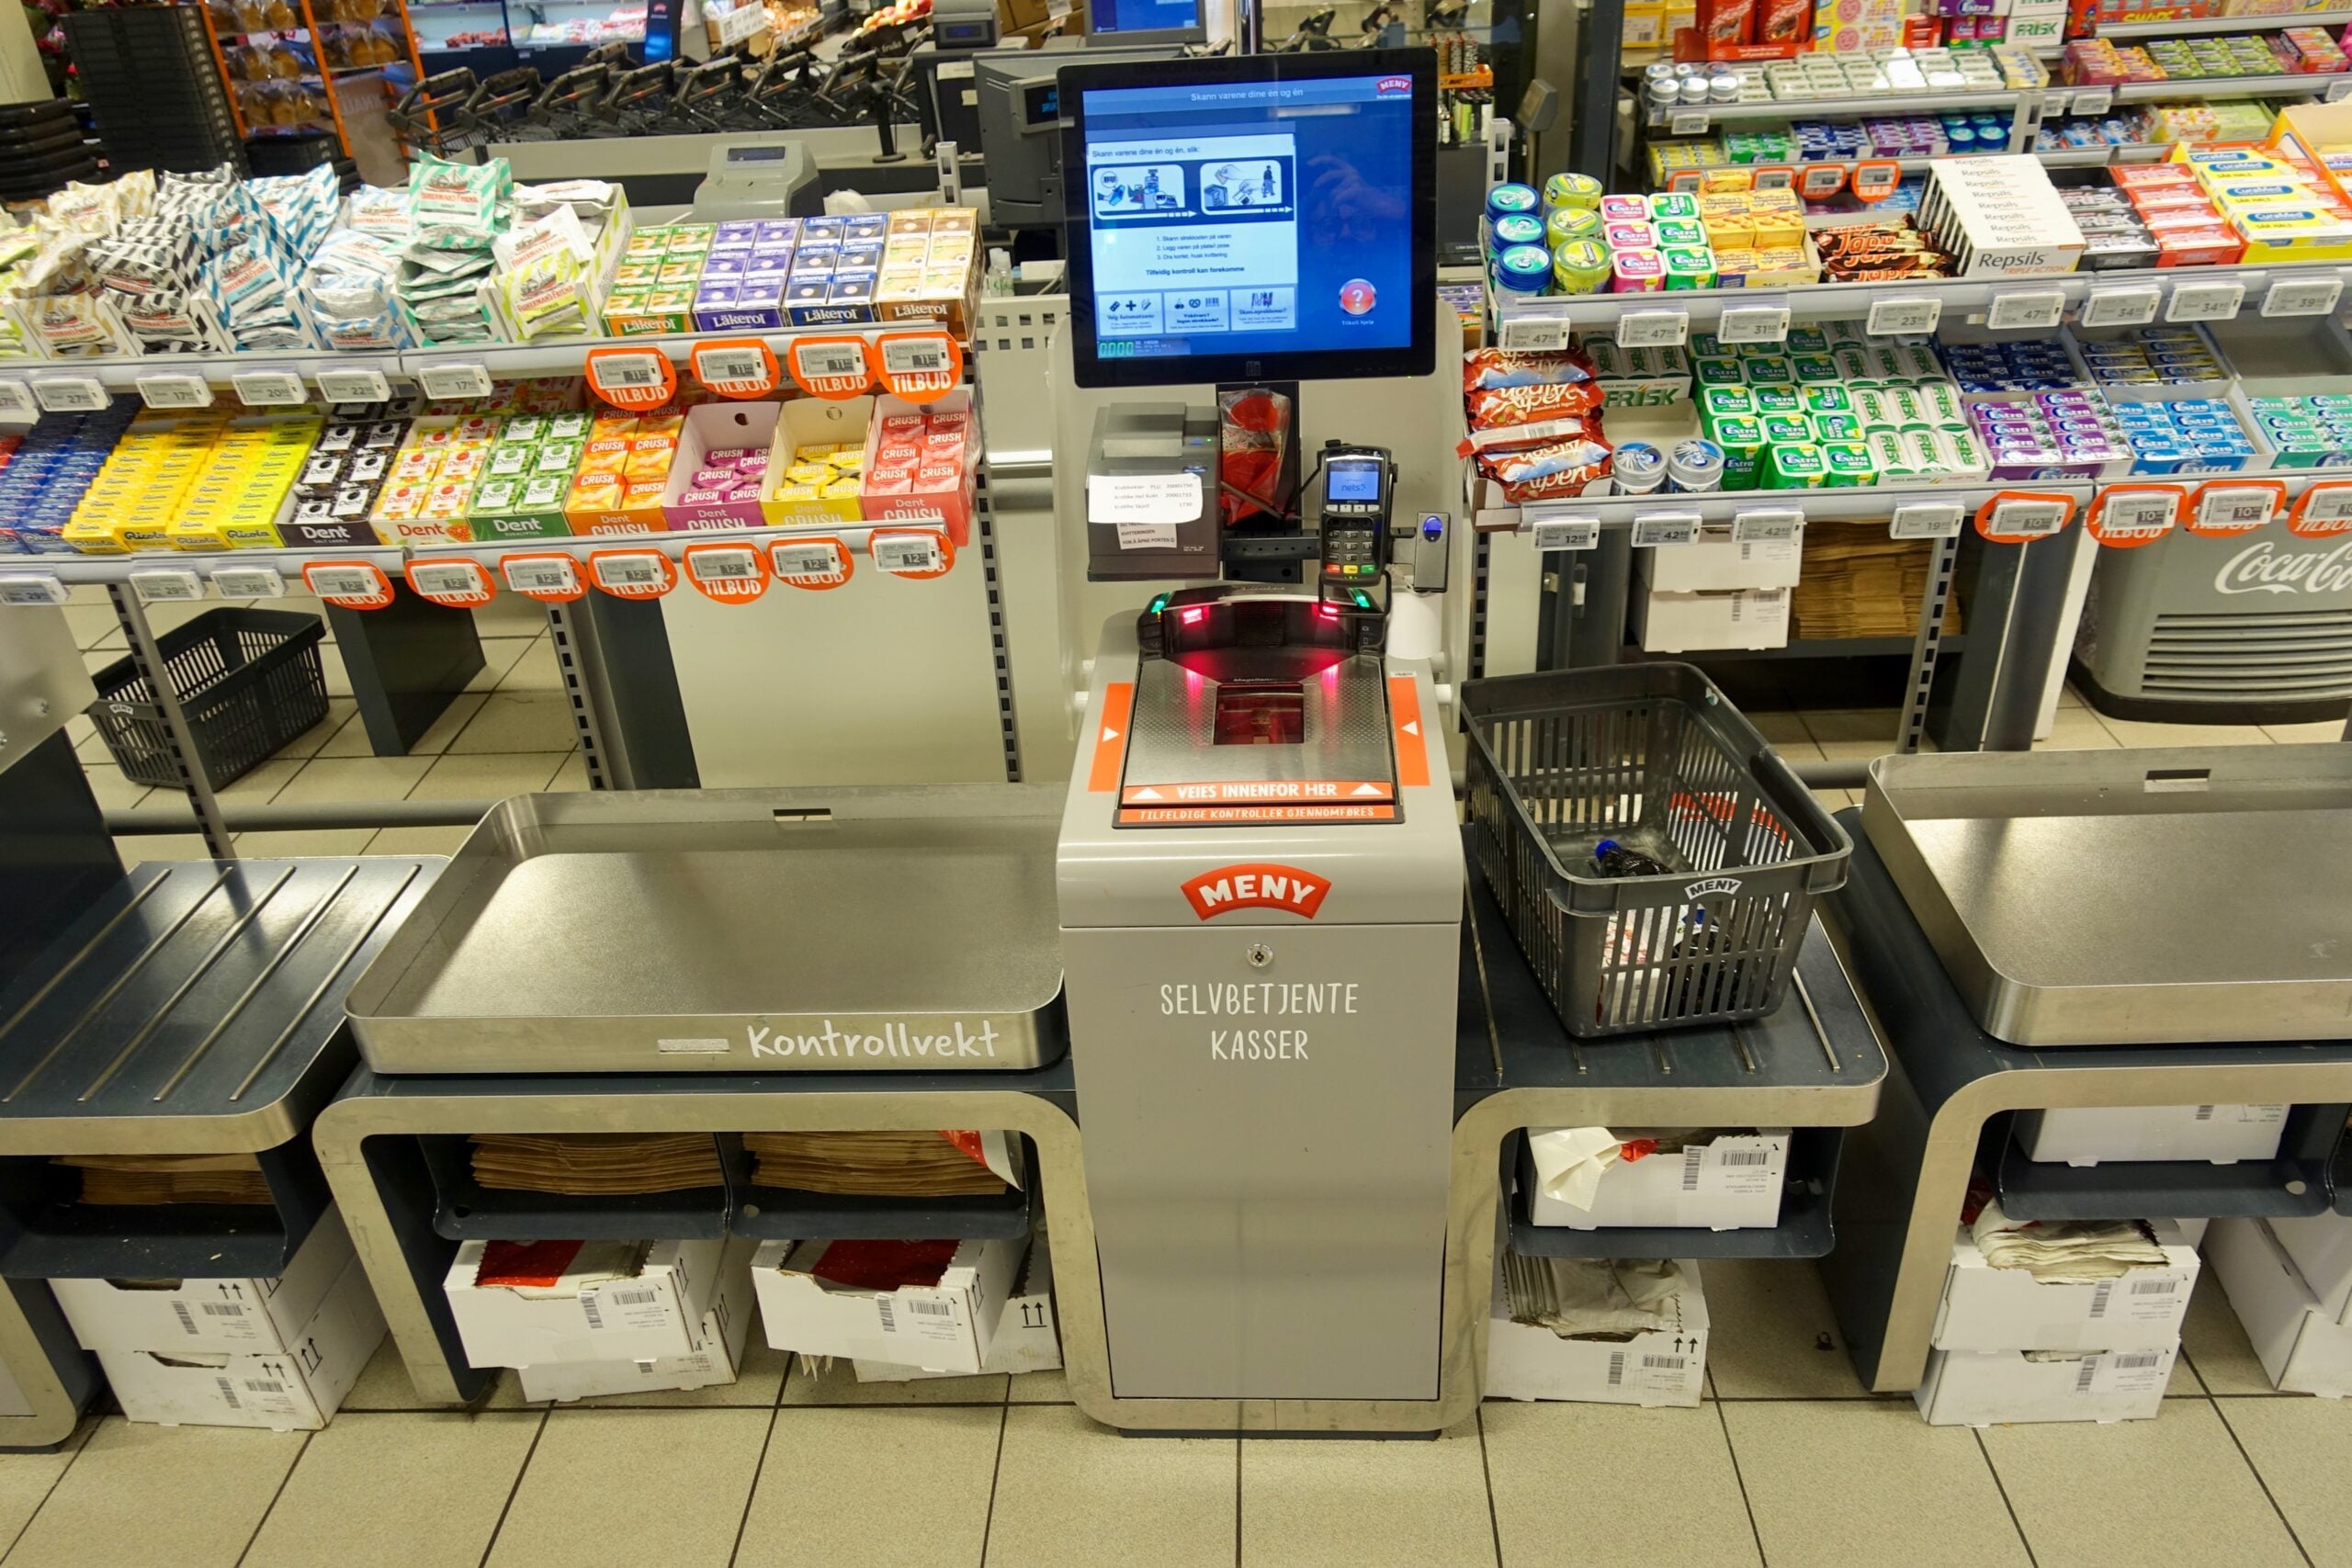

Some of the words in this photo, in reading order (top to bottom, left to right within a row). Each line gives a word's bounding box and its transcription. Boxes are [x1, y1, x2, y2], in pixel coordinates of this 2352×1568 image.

[2015, 22, 2058, 37] FRISK
[1380, 78, 1408, 90] MENY
[1191, 93, 1216, 101] Skann
[1218, 92, 1246, 100] varene
[1248, 90, 1266, 98] dine
[1280, 90, 1291, 98] og
[1962, 168, 2001, 177] Repsils
[1965, 180, 2005, 188] Repsils
[1972, 190, 2012, 198] Repsils
[1611, 204, 1643, 212] Extra
[1978, 201, 2018, 210] Repsils
[1984, 213, 2024, 221] Repsils
[1991, 224, 2030, 232] Repsils
[1618, 231, 1649, 240] Extra
[1996, 235, 2037, 244] Repsils
[1832, 234, 1896, 256] Japp
[1626, 260, 1657, 268] Extra
[1675, 256, 1708, 265] Extra
[1978, 252, 2046, 269] Repsils
[552, 286, 574, 299] FRIEND
[804, 304, 858, 321] Läkerol
[894, 303, 948, 317] Läkerol
[623, 318, 675, 333] Läkerol
[713, 314, 765, 328] Läkerol
[713, 379, 772, 392] TILBUD
[807, 376, 867, 392] TILBUD
[891, 372, 952, 393] TILBUD
[606, 387, 668, 403] TILBUD
[1605, 389, 1680, 407] FRISK
[1860, 393, 1883, 421] FRISK
[1895, 391, 1918, 420] FRISK
[1932, 386, 1954, 419] FRISK
[603, 411, 636, 420] CRUSH
[933, 413, 965, 424] CRUSH
[1990, 411, 2024, 419] Extra
[888, 416, 921, 427] CRUSH
[1726, 426, 1758, 434] Extra
[1774, 425, 1805, 434] Extra
[1996, 424, 2029, 434] Extra
[636, 439, 670, 450] CRUSH
[928, 433, 962, 445] CRUSH
[591, 441, 625, 452] CRUSH
[1879, 434, 1902, 465] FRISK
[1915, 434, 1939, 464] FRISK
[1954, 434, 1976, 466] FRISK
[711, 449, 743, 460] CRUSH
[882, 448, 916, 459] CRUSH
[1837, 453, 1868, 463] Extra
[1727, 460, 1755, 468] Extra
[1786, 456, 1818, 464] Extra
[698, 470, 731, 481] CRUSH
[792, 466, 824, 477] CRUSH
[873, 469, 907, 480] CRUSH
[920, 467, 954, 479] CRUSH
[581, 475, 616, 486] CRUSH
[630, 482, 665, 494] CRUSH
[780, 486, 813, 496] CRUSH
[684, 491, 718, 502] CRUSH
[601, 515, 630, 524] Dent
[697, 510, 727, 518] Dent
[397, 524, 446, 536] Dent
[492, 518, 543, 532] Dent
[227, 530, 270, 538] Ricola
[300, 525, 351, 538] Dent
[2098, 526, 2164, 538] TILBUD
[788, 573, 844, 584] TILBUD
[611, 582, 670, 595] TILBUD
[702, 580, 762, 595] TILBUD
[433, 592, 490, 603] TILBUD
[1177, 786, 1216, 799] VEIES
[1223, 784, 1298, 797] INNENFOR
[1305, 784, 1338, 796] HER
[1139, 809, 1206, 820] TILFELDIGE
[1210, 808, 1283, 819] KONTROLLER
[1286, 807, 1374, 818] GJENNOMFØRES
[1198, 874, 1317, 908] MENY
[1689, 880, 1738, 897] MENY
[1160, 983, 1359, 1015] SELVBETJENTE
[746, 1020, 1000, 1058] Kontrollvekt
[1211, 1030, 1309, 1060] KASSER
